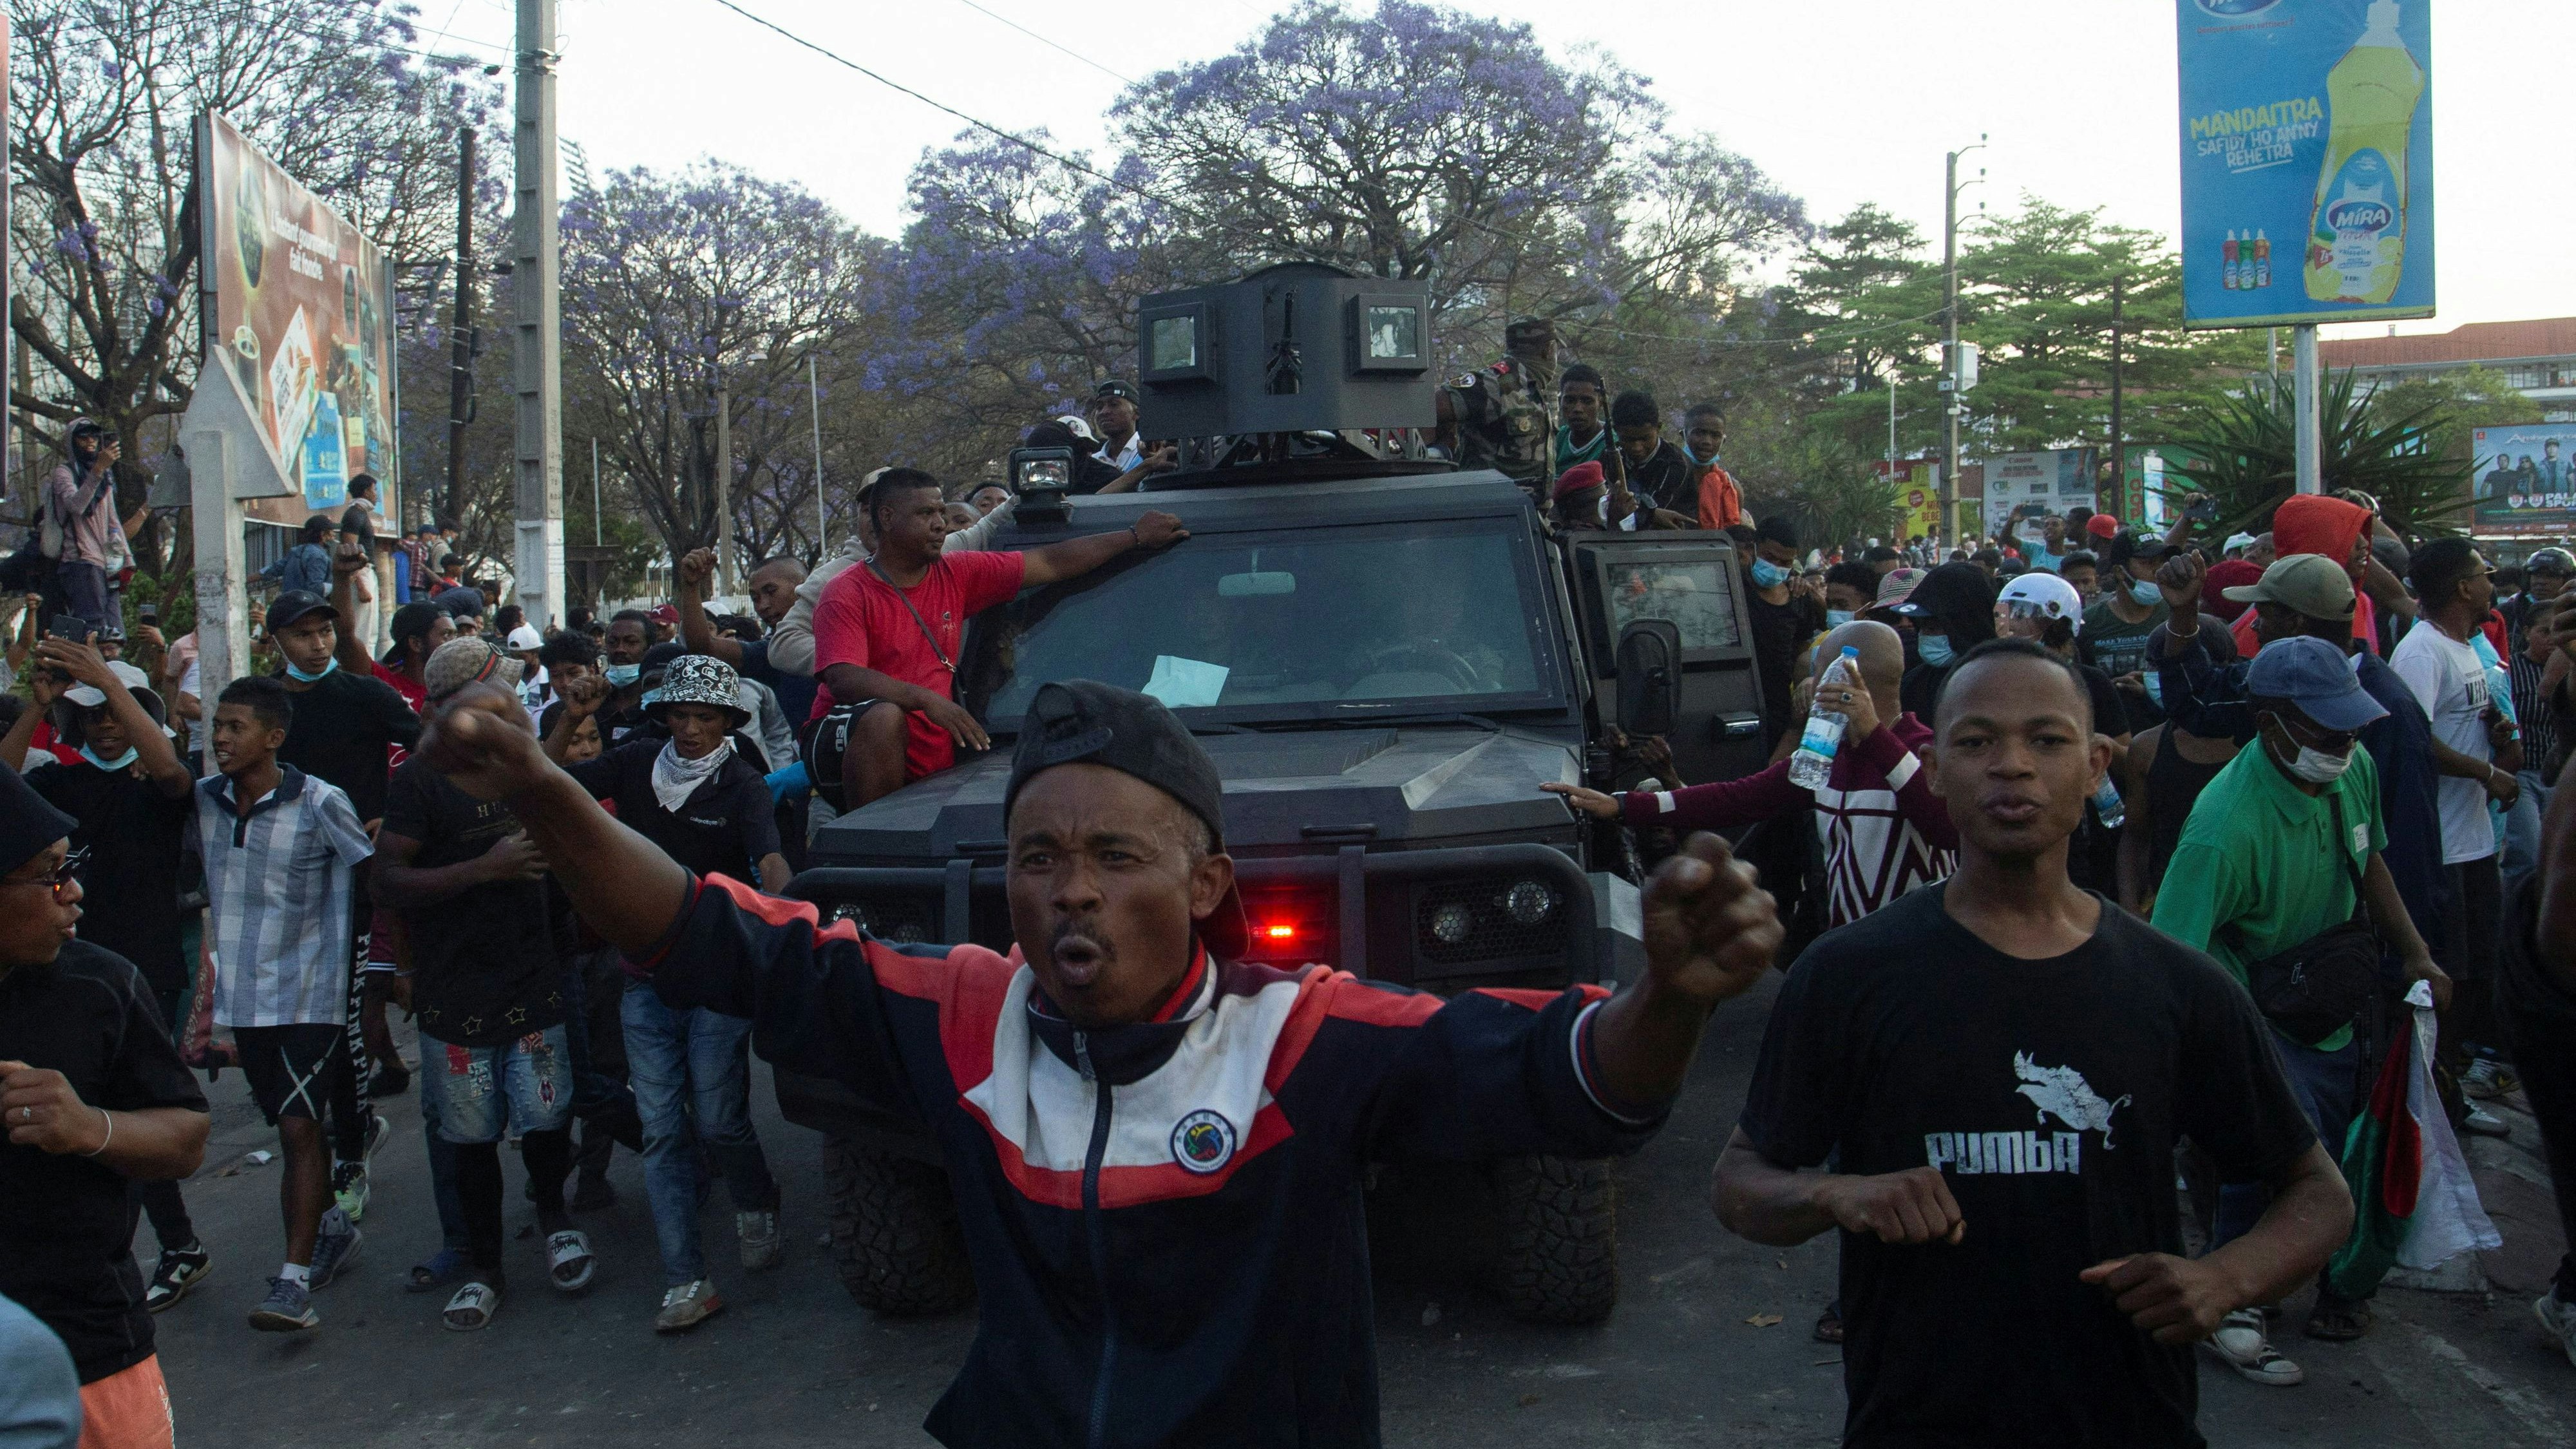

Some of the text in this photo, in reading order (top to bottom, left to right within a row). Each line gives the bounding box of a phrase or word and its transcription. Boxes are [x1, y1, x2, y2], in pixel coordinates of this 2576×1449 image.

[2191, 97, 2323, 139] MANDAITRA
[2197, 133, 2246, 156] SAFIDY
[2251, 130, 2272, 146] HO
[2226, 143, 2293, 167] REHETRA
[354, 932, 372, 992] PINK
[348, 996, 365, 1054] PINK
